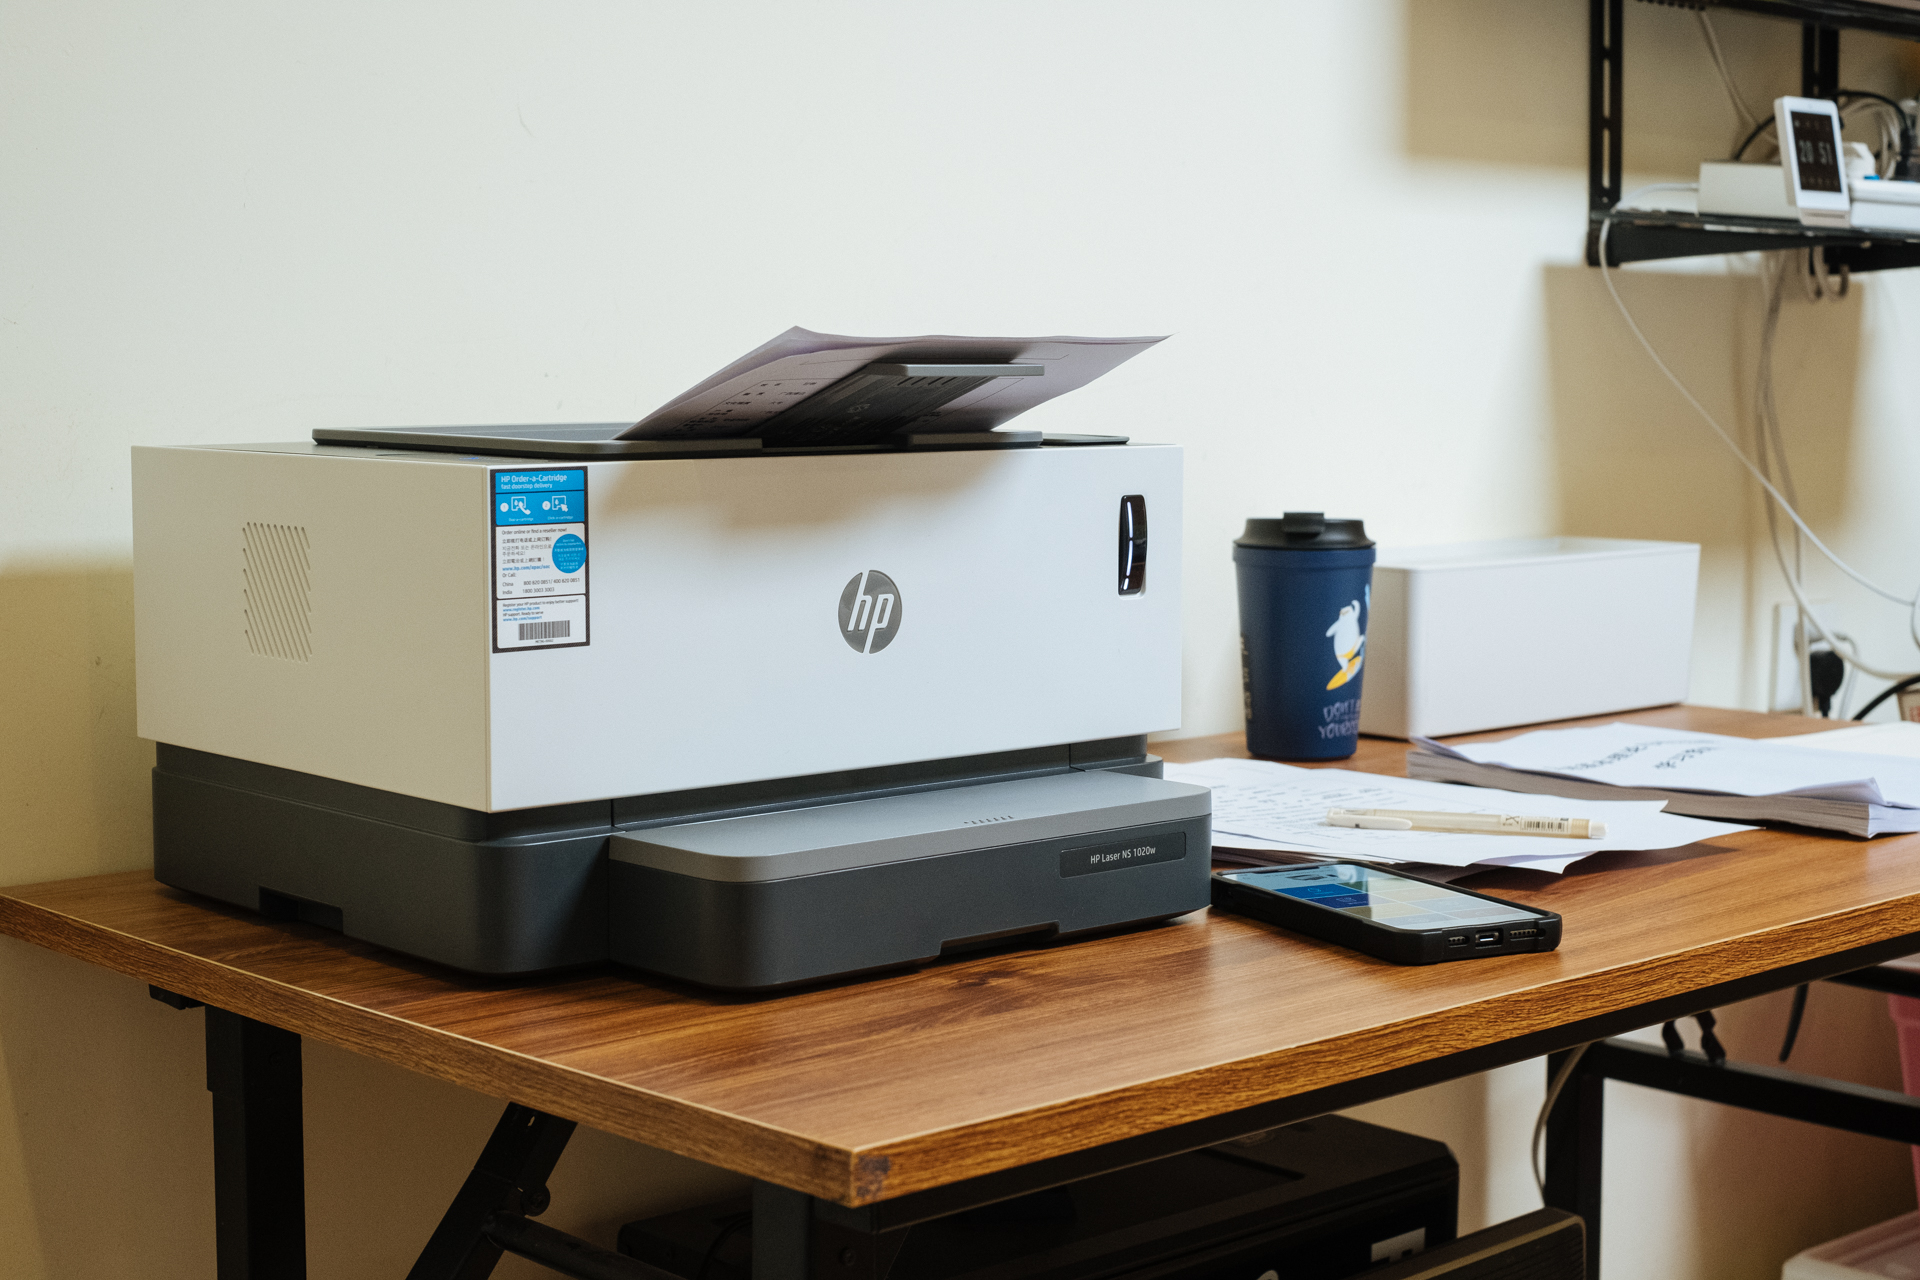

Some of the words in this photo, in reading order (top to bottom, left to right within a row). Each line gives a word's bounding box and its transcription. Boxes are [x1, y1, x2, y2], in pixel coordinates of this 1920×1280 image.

[847, 569, 895, 654] hp
[1090, 854, 1101, 865] HP
[1101, 851, 1120, 863] Laser
[1121, 849, 1132, 859] NS
[1133, 846, 1156, 858] 1020w
